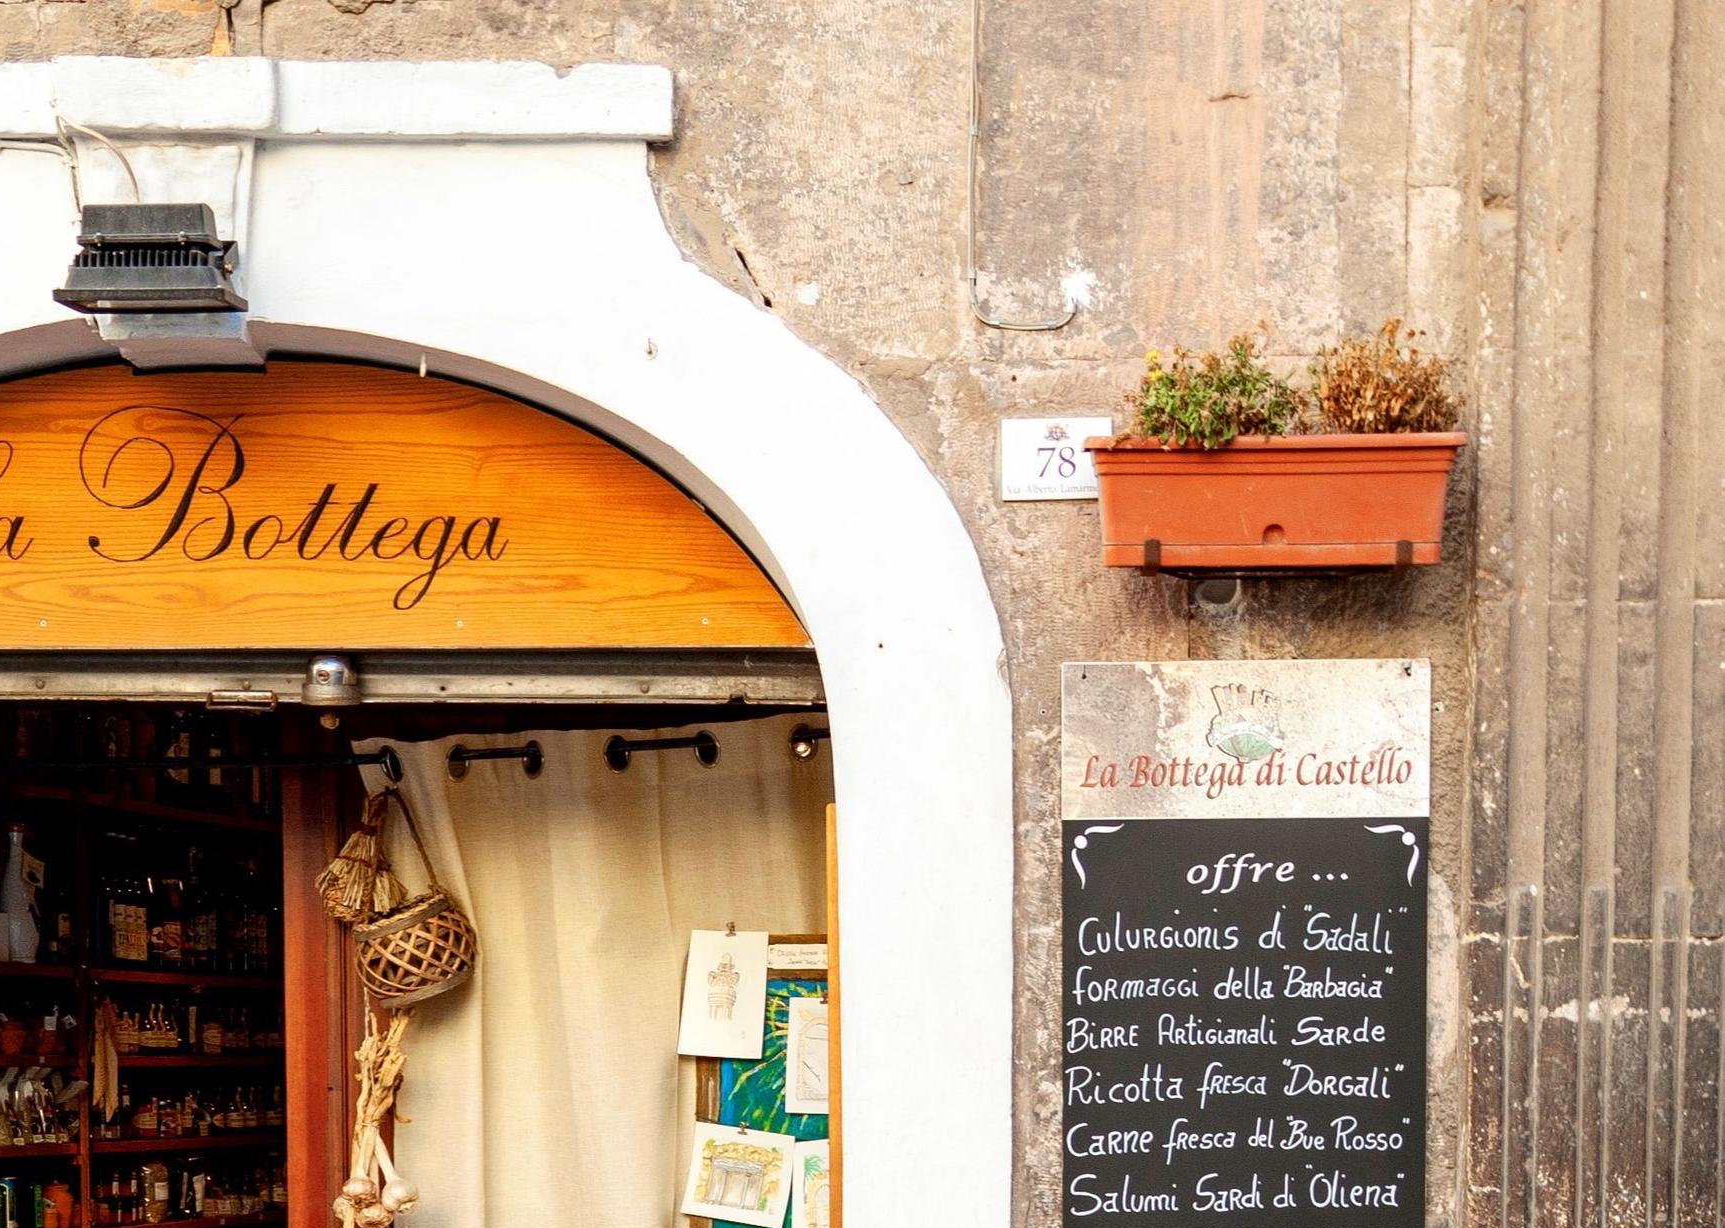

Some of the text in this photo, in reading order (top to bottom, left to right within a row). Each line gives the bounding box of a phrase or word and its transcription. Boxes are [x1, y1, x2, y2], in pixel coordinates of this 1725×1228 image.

[1037, 446, 1076, 478] 78
[78, 405, 510, 611] Bottega
[1079, 747, 1413, 799] La Bottega di Castello
[1186, 853, 1295, 894] offre
[1259, 905, 1286, 950] di
[1214, 966, 1275, 1000] della
[1066, 1013, 1386, 1054] Birre Artigianali Sarde
[1065, 1063, 1183, 1106] Ricotta
[1197, 1062, 1267, 1110] fresca
[1066, 1122, 1154, 1157] Carne
[1162, 1117, 1236, 1165] fresca
[1248, 1117, 1275, 1149] del
[1070, 1173, 1179, 1216] Salumi
[1192, 1172, 1264, 1213] Sardi
[1273, 1172, 1297, 1208] di
